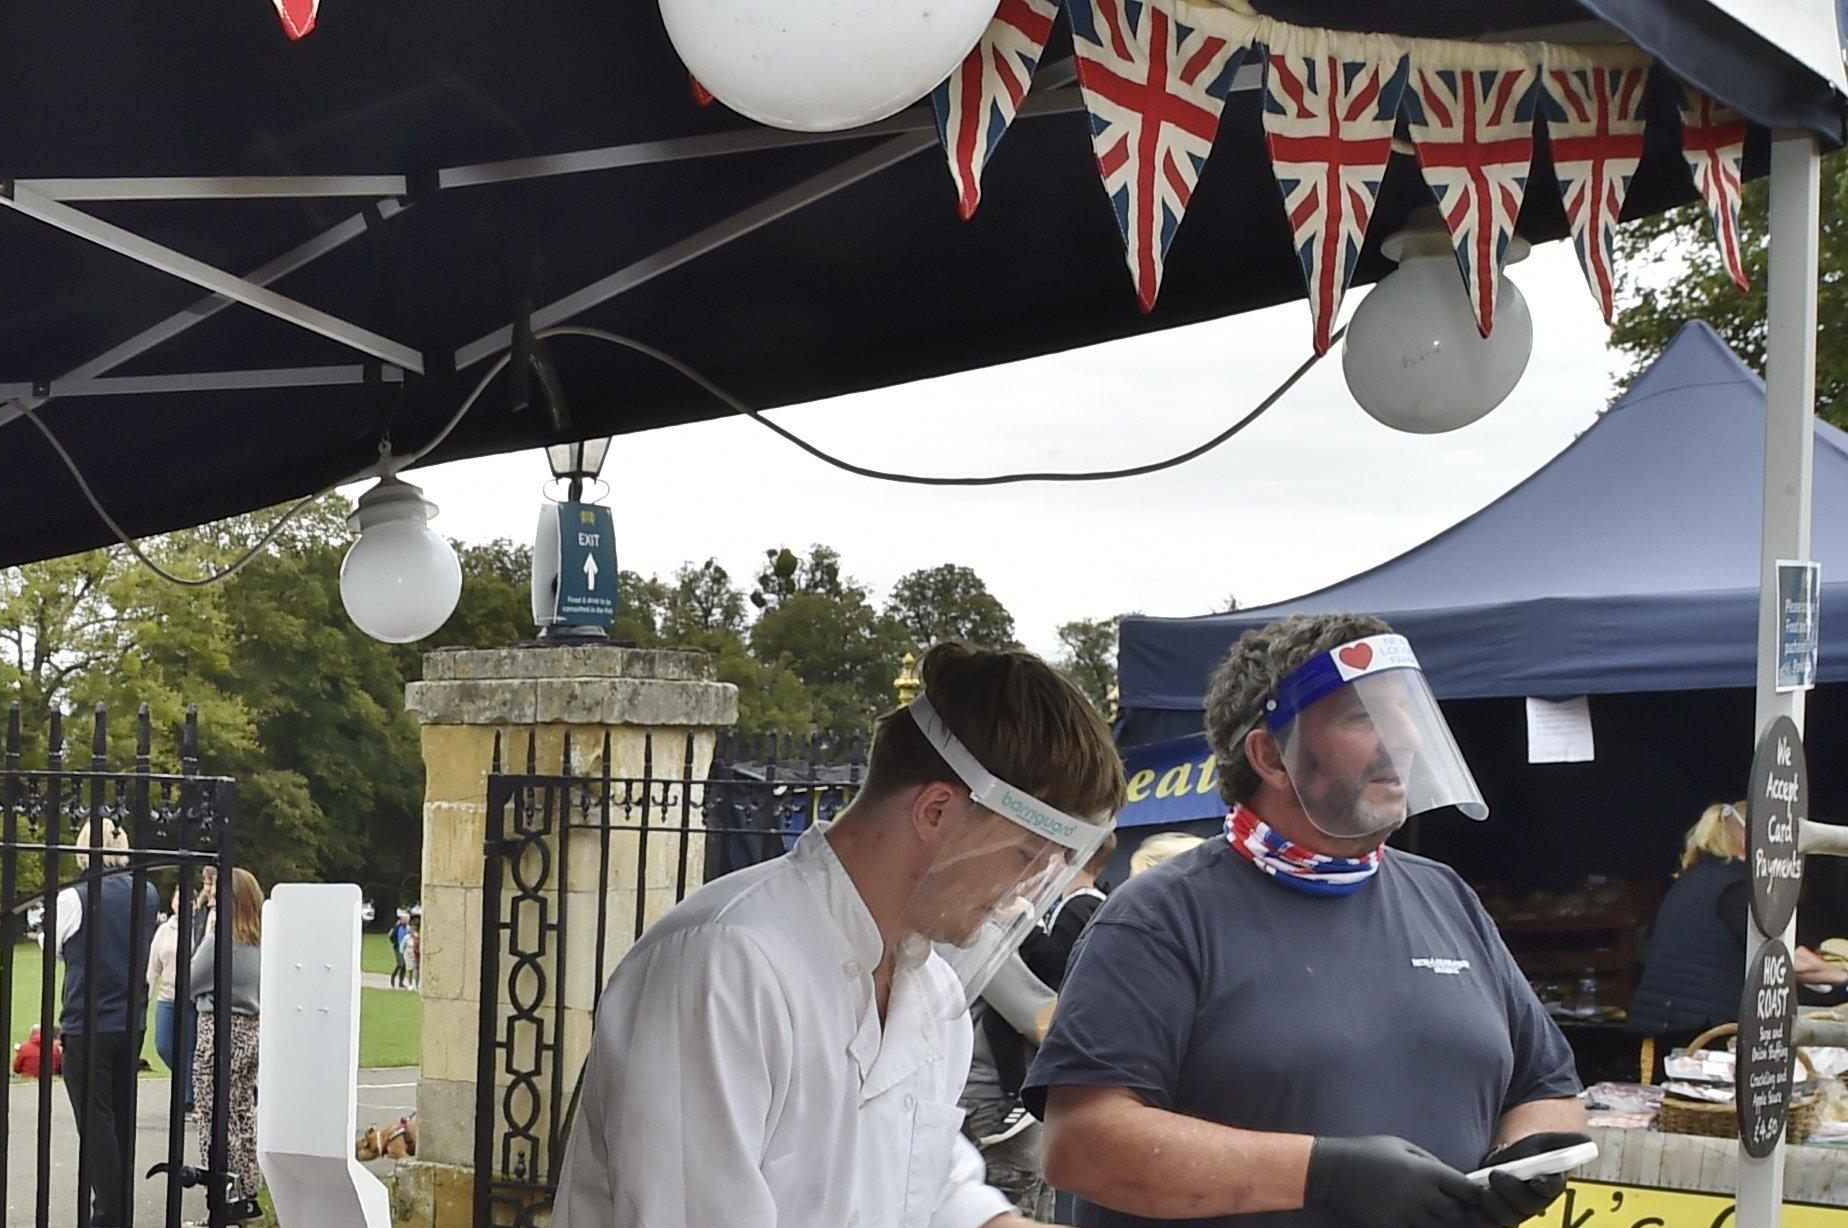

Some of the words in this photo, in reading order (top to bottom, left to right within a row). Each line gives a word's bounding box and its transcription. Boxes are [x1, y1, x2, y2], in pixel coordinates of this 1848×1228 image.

[578, 533, 600, 547] EXIT
[1777, 736, 1792, 767] We
[1127, 754, 1218, 802] eat
[1766, 772, 1799, 818] Accept
[1768, 814, 1793, 844] Card
[1755, 848, 1802, 895] Payments
[1763, 955, 1787, 986] HOG
[1757, 987, 1790, 1020] ROAST
